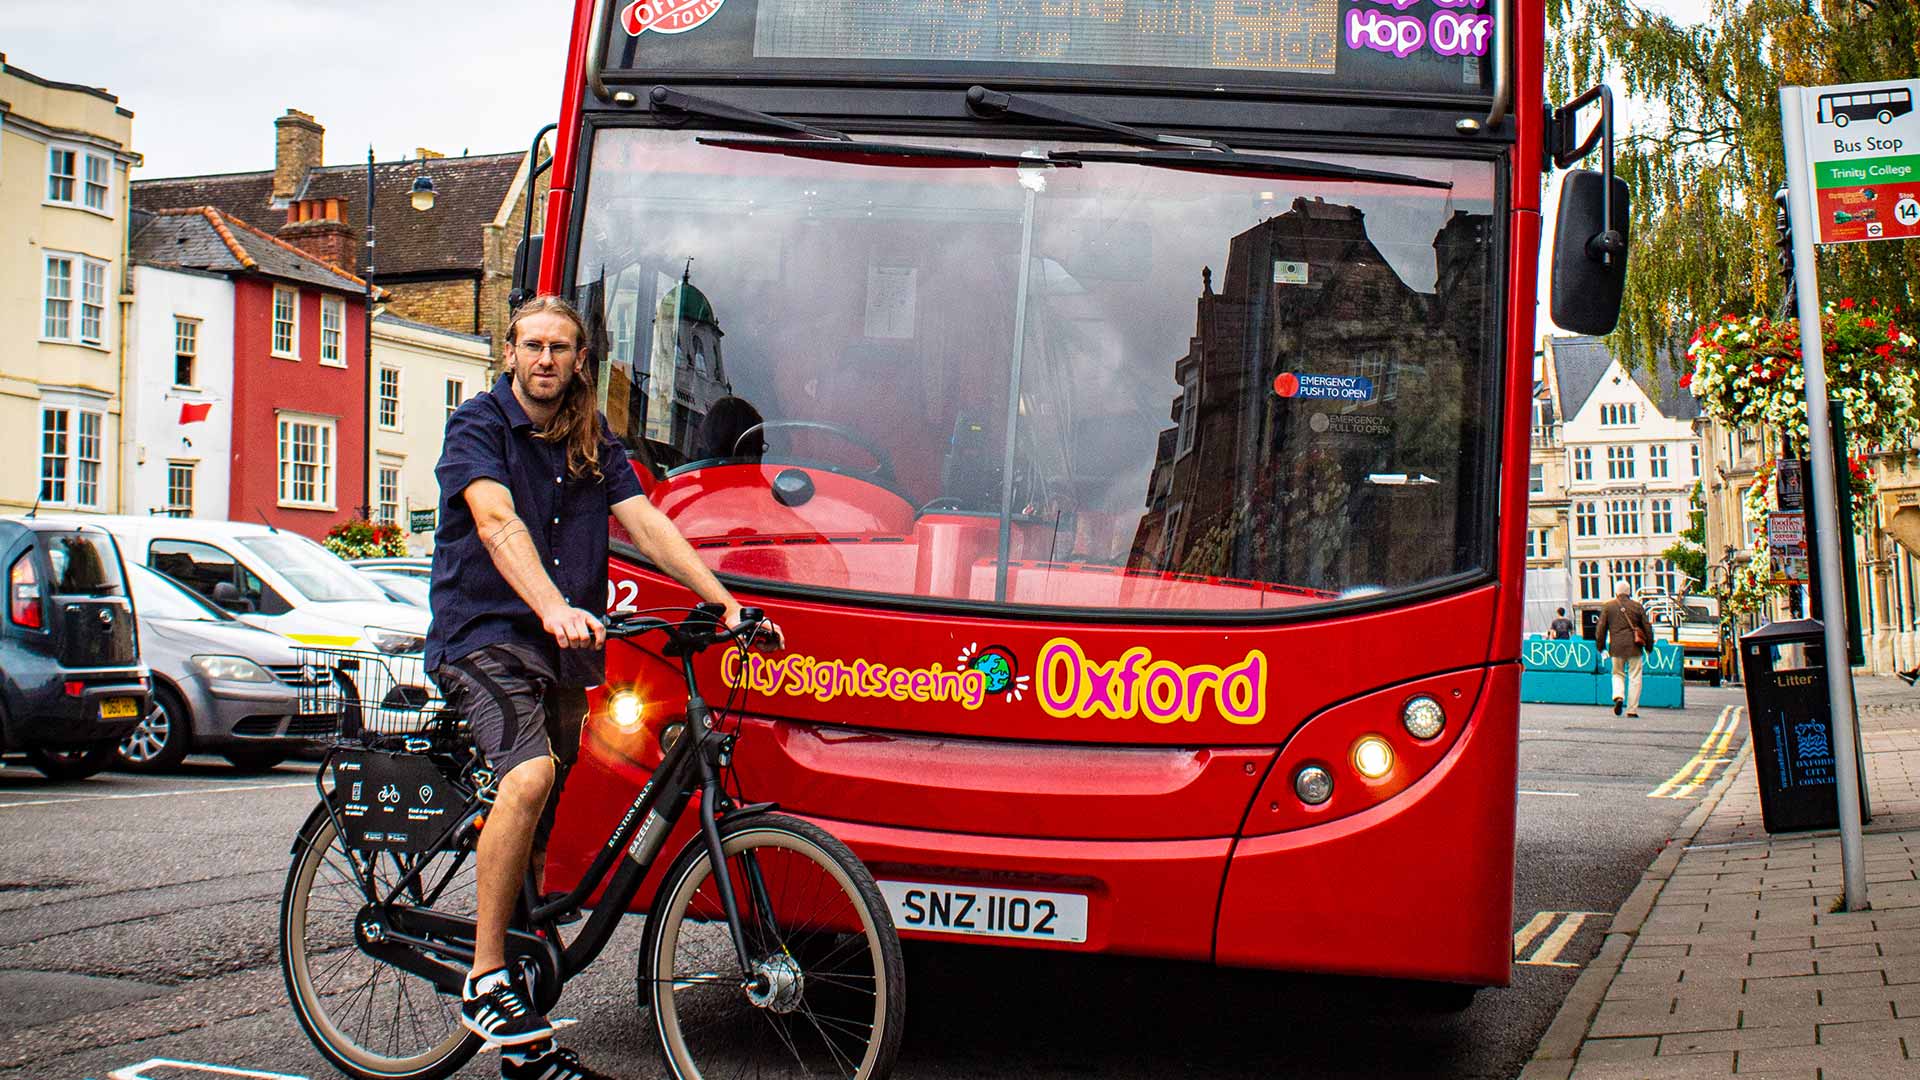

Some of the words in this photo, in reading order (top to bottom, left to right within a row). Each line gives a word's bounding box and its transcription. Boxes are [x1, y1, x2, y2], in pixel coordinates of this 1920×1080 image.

[925, 19, 981, 58] Top
[995, 22, 1071, 56] Tour
[1348, 11, 1424, 56] Hop
[1431, 11, 1491, 54] Off
[1834, 139, 1862, 153] Bus
[1866, 137, 1903, 152] Stop
[1831, 168, 1866, 179] Trinity
[1869, 165, 1912, 176] College
[1899, 203, 1918, 219] 14
[1300, 376, 1357, 387] EMERGENCY
[1300, 387, 1324, 397] PUSH
[1327, 388, 1339, 397] TO
[1341, 389, 1366, 398] OPEN
[1329, 415, 1385, 425] EMERGENCY
[1351, 424, 1364, 433] TO
[1365, 425, 1390, 434] OPEN
[1530, 642, 1591, 668] BROAD
[1036, 638, 1268, 724] Oxford
[1777, 675, 1813, 687] Litter
[629, 811, 657, 855] GAZELLE
[904, 889, 977, 929] SNZ
[987, 895, 1057, 935] 1102
